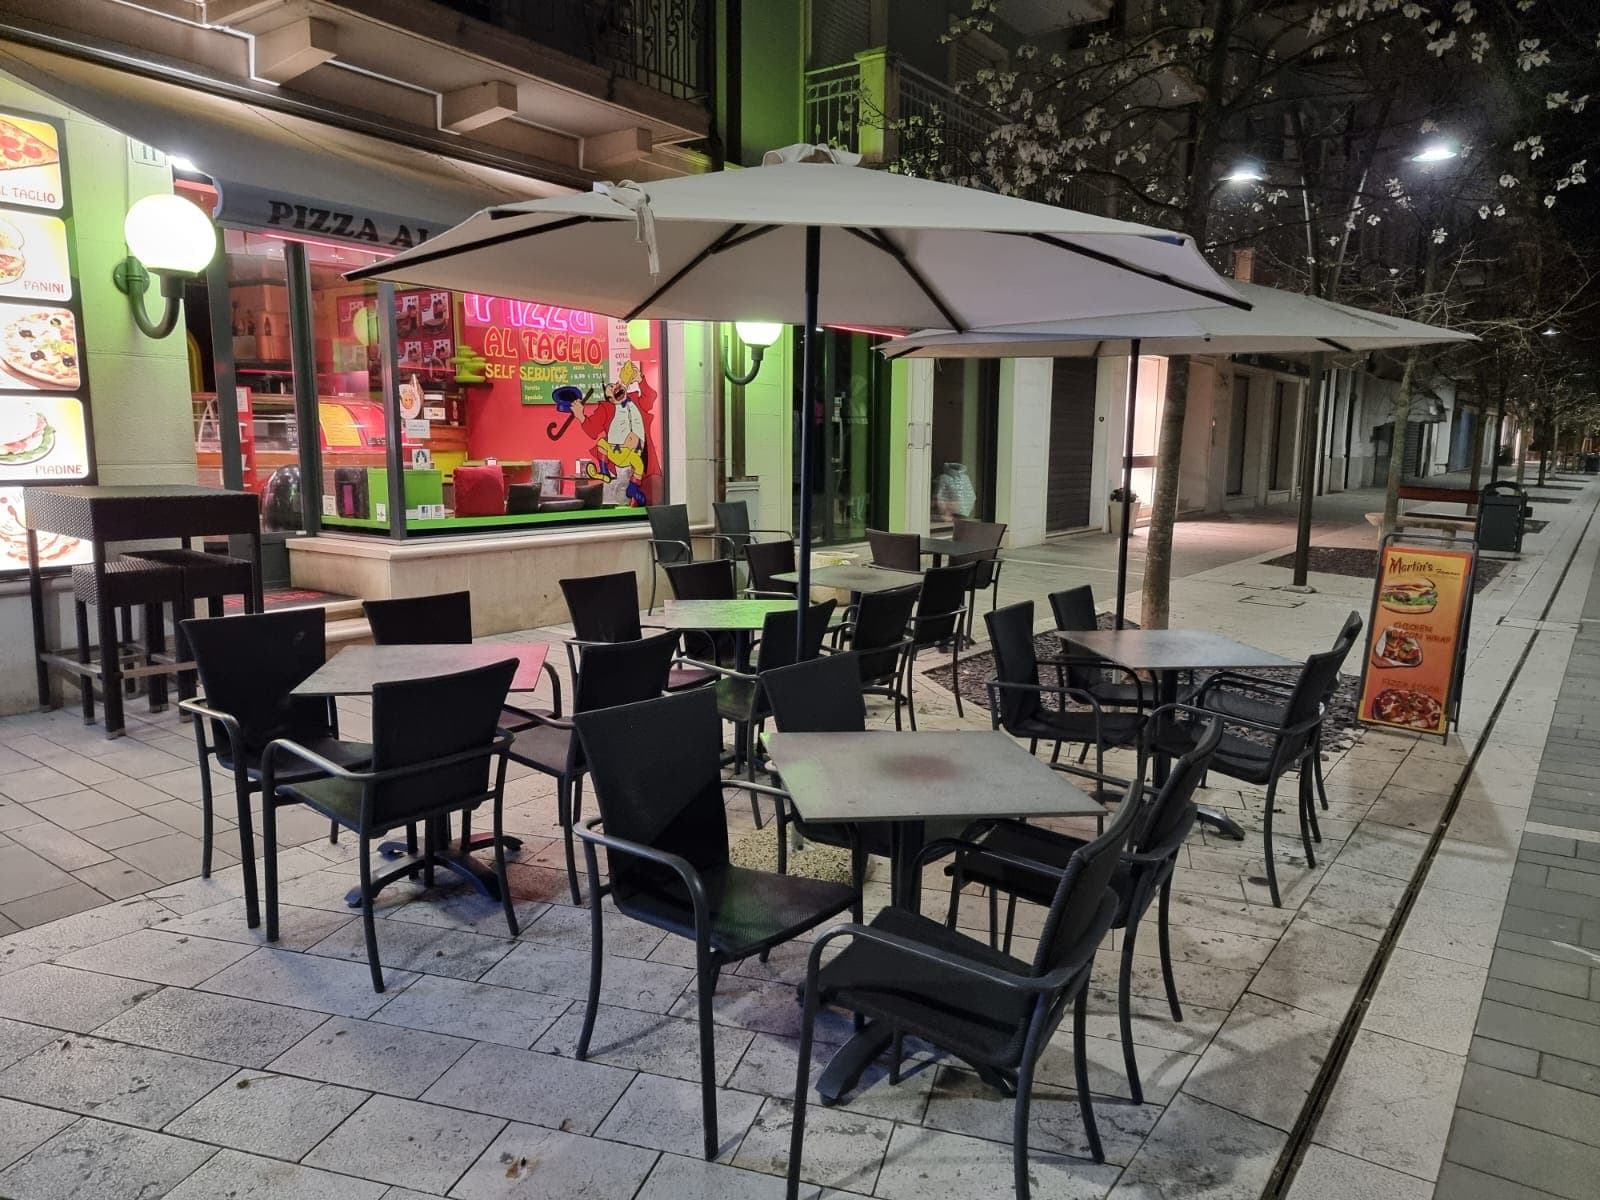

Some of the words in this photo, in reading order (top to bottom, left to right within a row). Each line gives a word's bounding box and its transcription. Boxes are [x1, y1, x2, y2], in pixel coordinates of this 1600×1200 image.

[11, 187, 56, 204] TAGLIO
[267, 200, 380, 243] PIZZA
[23, 280, 65, 294] PANINI
[484, 325, 518, 359] AL
[521, 329, 603, 366] TAGLIO
[485, 362, 516, 379] SELF
[35, 464, 82, 475] PIADINE
[1389, 556, 1433, 575] Martin's
